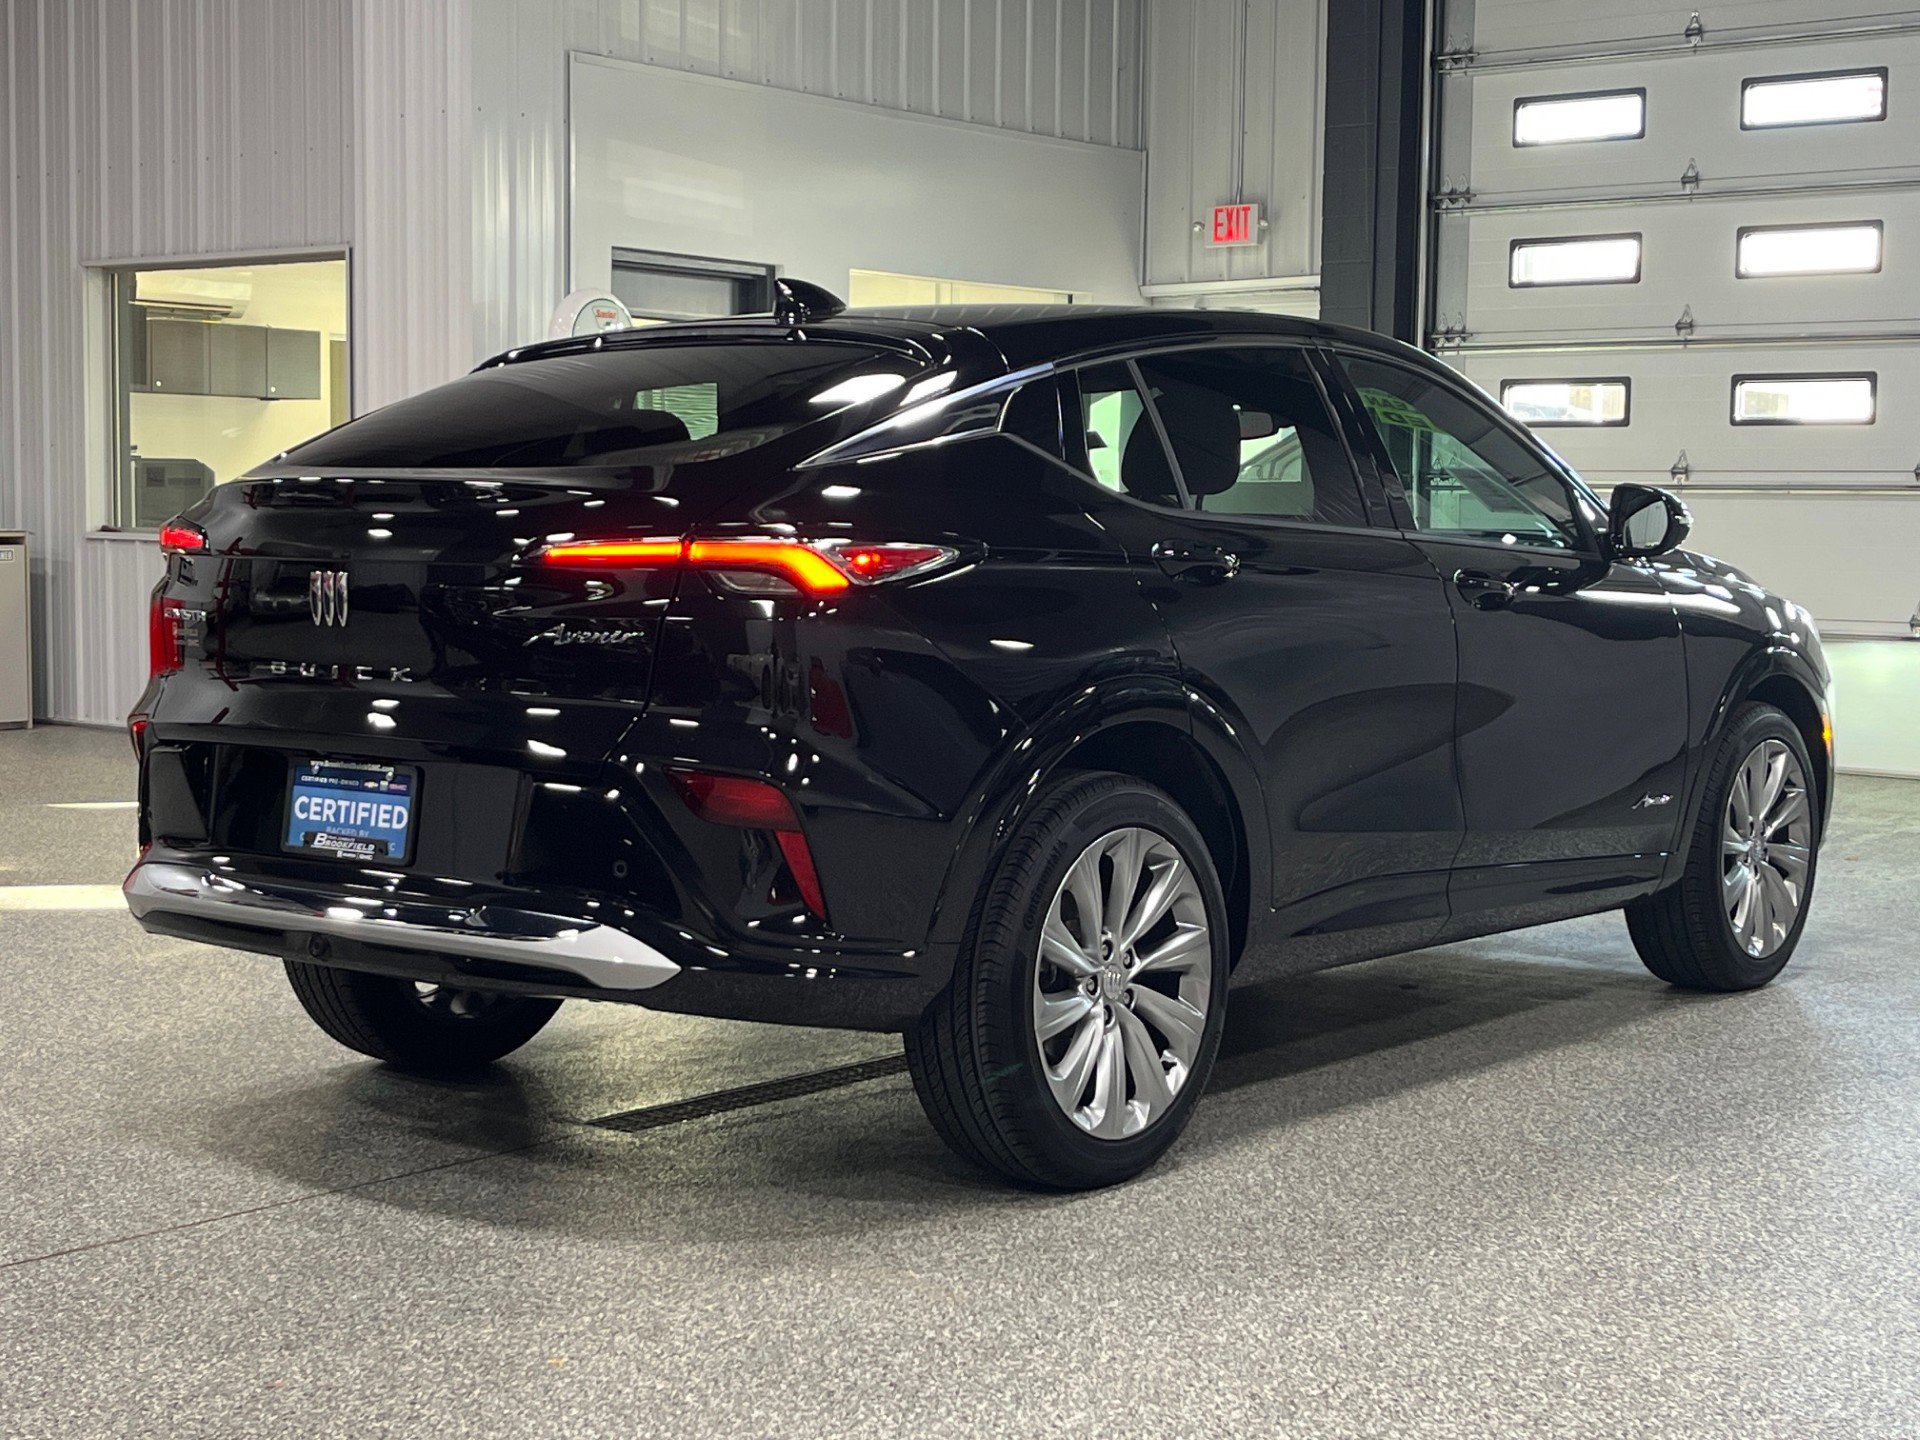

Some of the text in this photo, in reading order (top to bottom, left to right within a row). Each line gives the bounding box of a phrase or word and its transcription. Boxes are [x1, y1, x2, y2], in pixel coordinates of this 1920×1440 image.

[1214, 206, 1250, 242] EXIT
[522, 622, 645, 647] Avenir
[270, 661, 413, 683] BUICK
[294, 795, 408, 830] CERTIFIED
